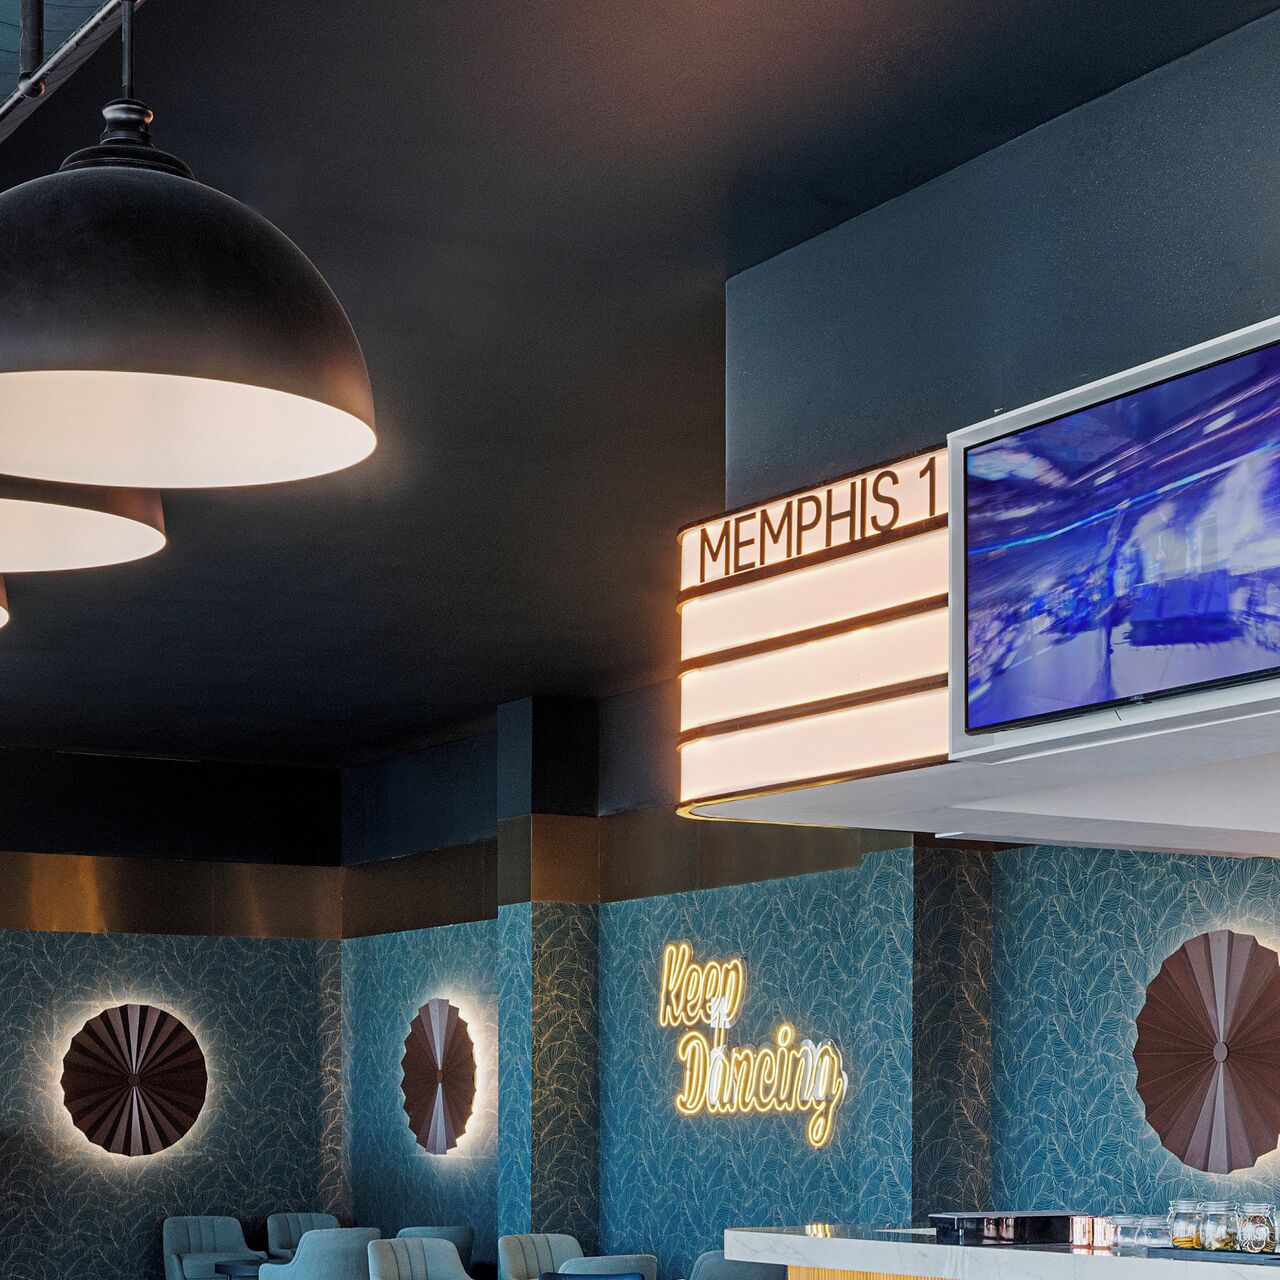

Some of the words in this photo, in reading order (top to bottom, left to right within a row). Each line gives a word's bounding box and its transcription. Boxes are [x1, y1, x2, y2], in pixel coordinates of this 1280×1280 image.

[699, 469, 900, 583] MEMPHIS
[919, 456, 936, 517] 1
[659, 943, 744, 1048] Keep
[676, 1025, 845, 1147] Dancing
